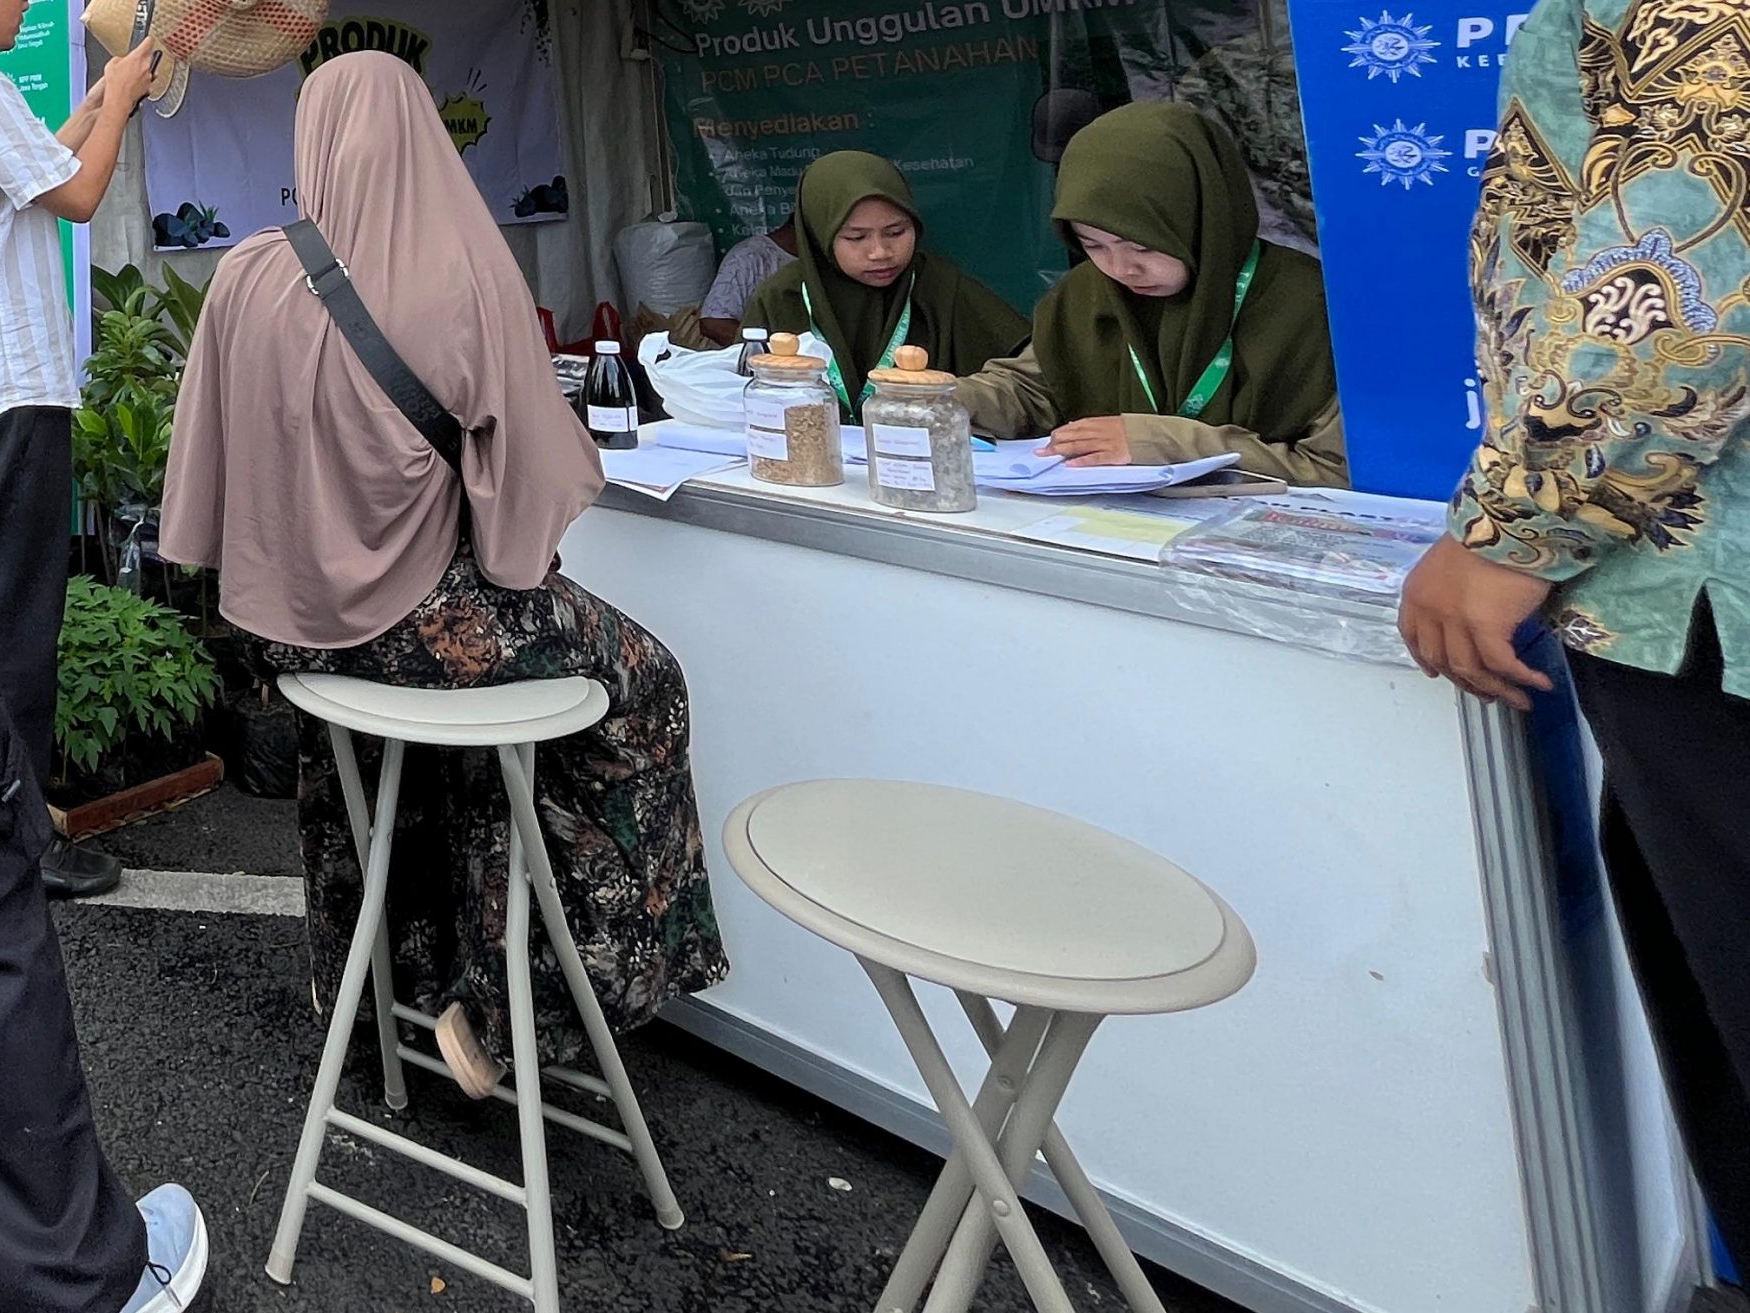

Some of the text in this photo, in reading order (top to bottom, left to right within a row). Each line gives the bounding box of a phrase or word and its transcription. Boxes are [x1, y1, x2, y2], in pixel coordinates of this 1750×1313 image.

[300, 20, 429, 76] PRODUK
[695, 21, 801, 58] Produk
[701, 34, 1038, 93] PCM PCA PETANAHAN
[445, 118, 478, 133] MKM
[692, 112, 859, 140] Menyediakan
[894, 154, 975, 172] Kesehatan
